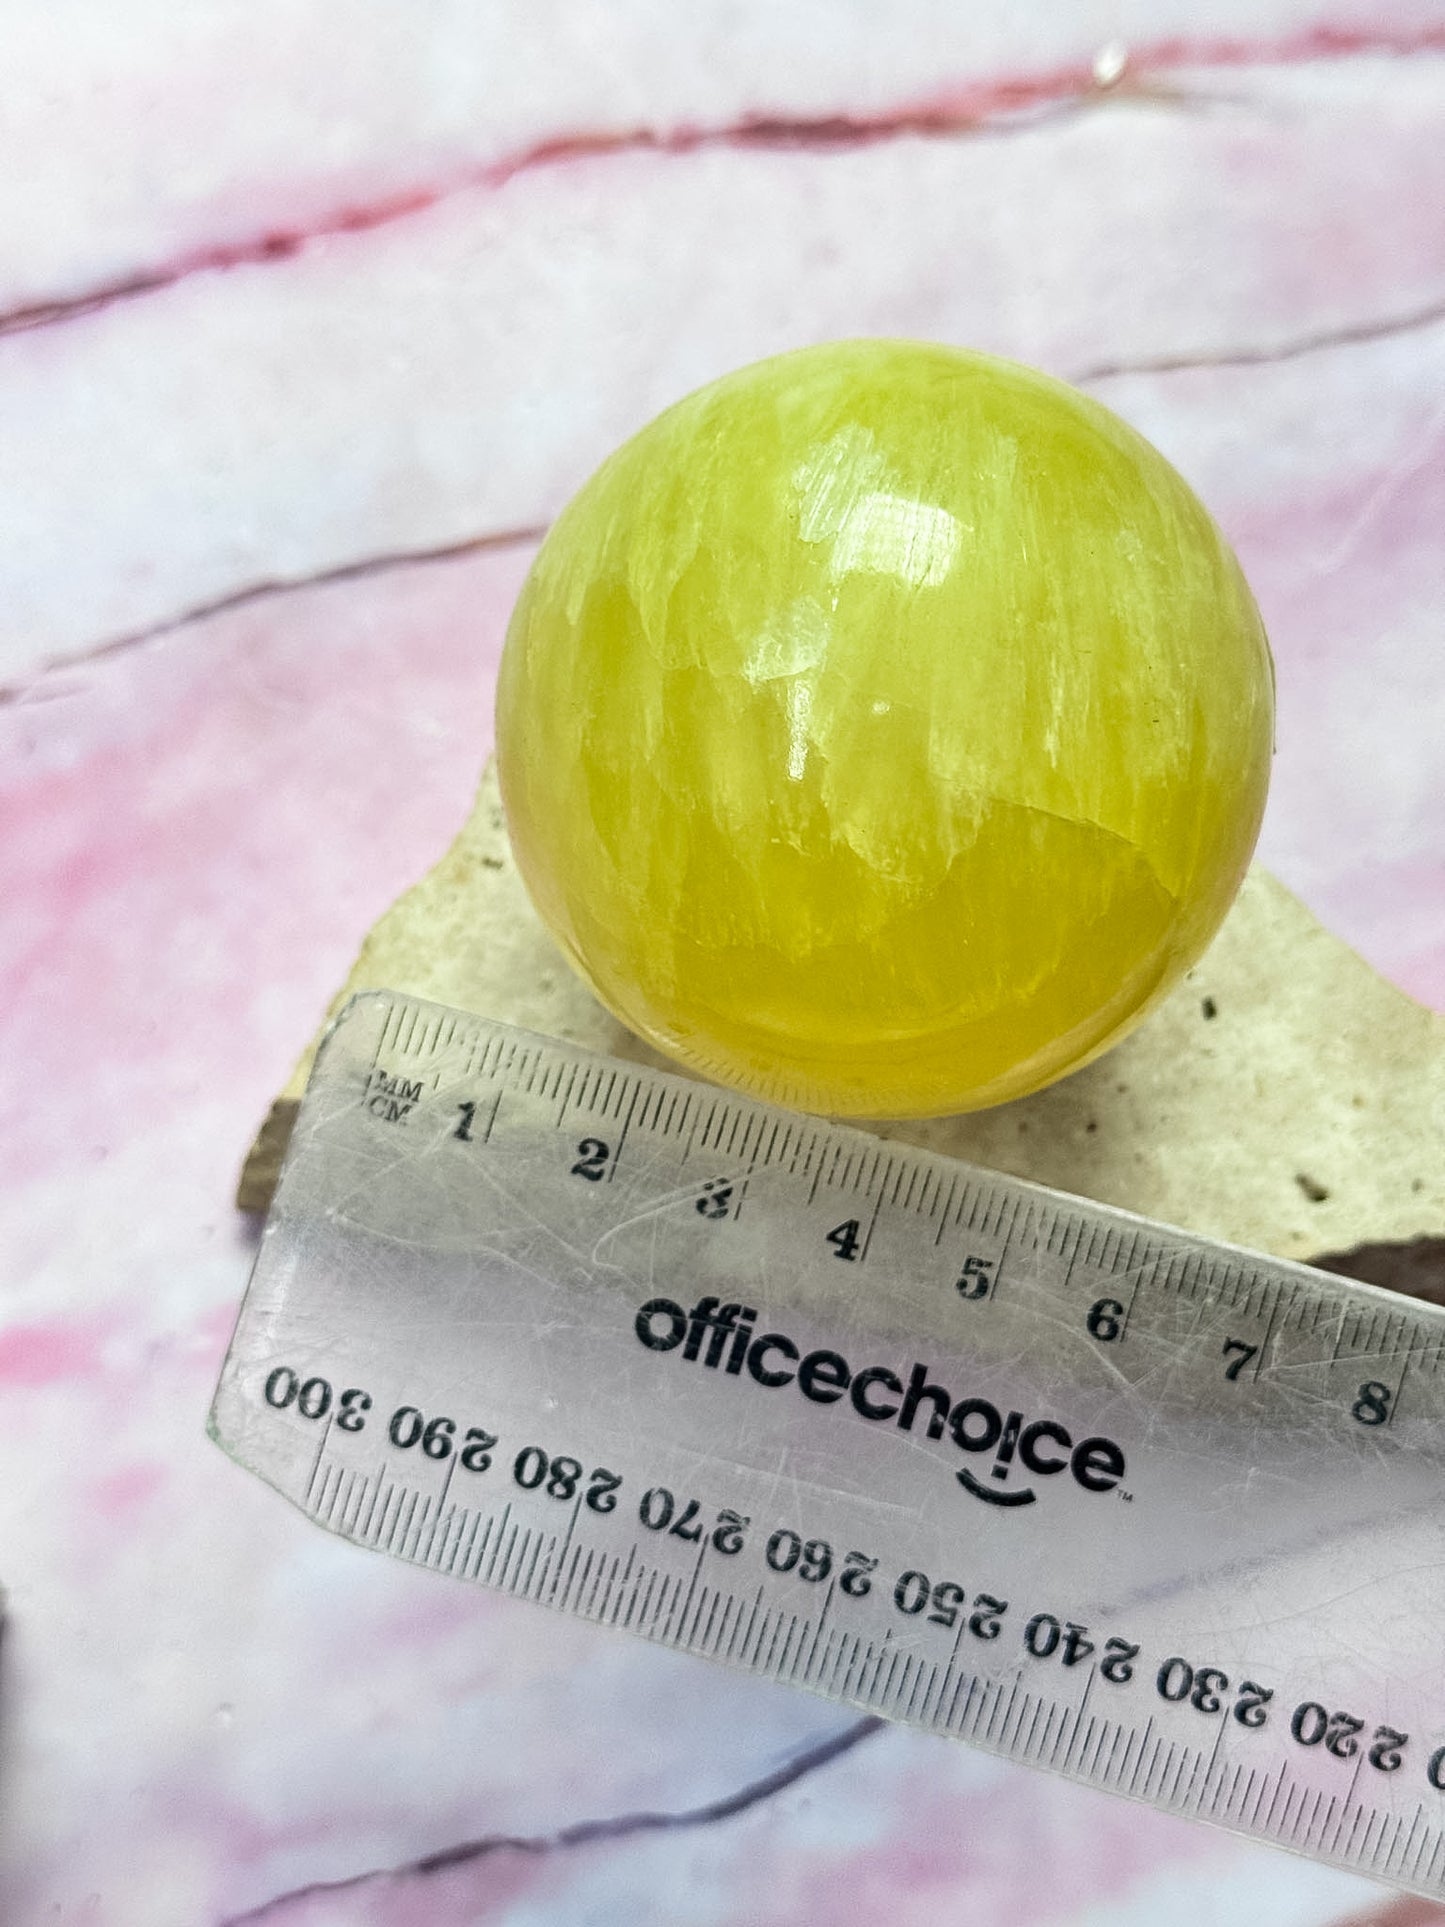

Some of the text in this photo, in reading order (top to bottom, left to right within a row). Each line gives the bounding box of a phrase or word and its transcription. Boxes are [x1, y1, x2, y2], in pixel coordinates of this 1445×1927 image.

[454, 1101, 1391, 1425] 1 2 3 4 5 6 7 8
[264, 1366, 373, 1432] 300
[389, 1406, 499, 1472] 290
[513, 1446, 623, 1513] 280
[639, 1487, 750, 1555] 270
[766, 1529, 878, 1597] 260
[894, 1570, 1008, 1639] 250
[1024, 1613, 1140, 1683] 240
[1156, 1657, 1273, 1727] 230
[1291, 1701, 1408, 1772] 220
